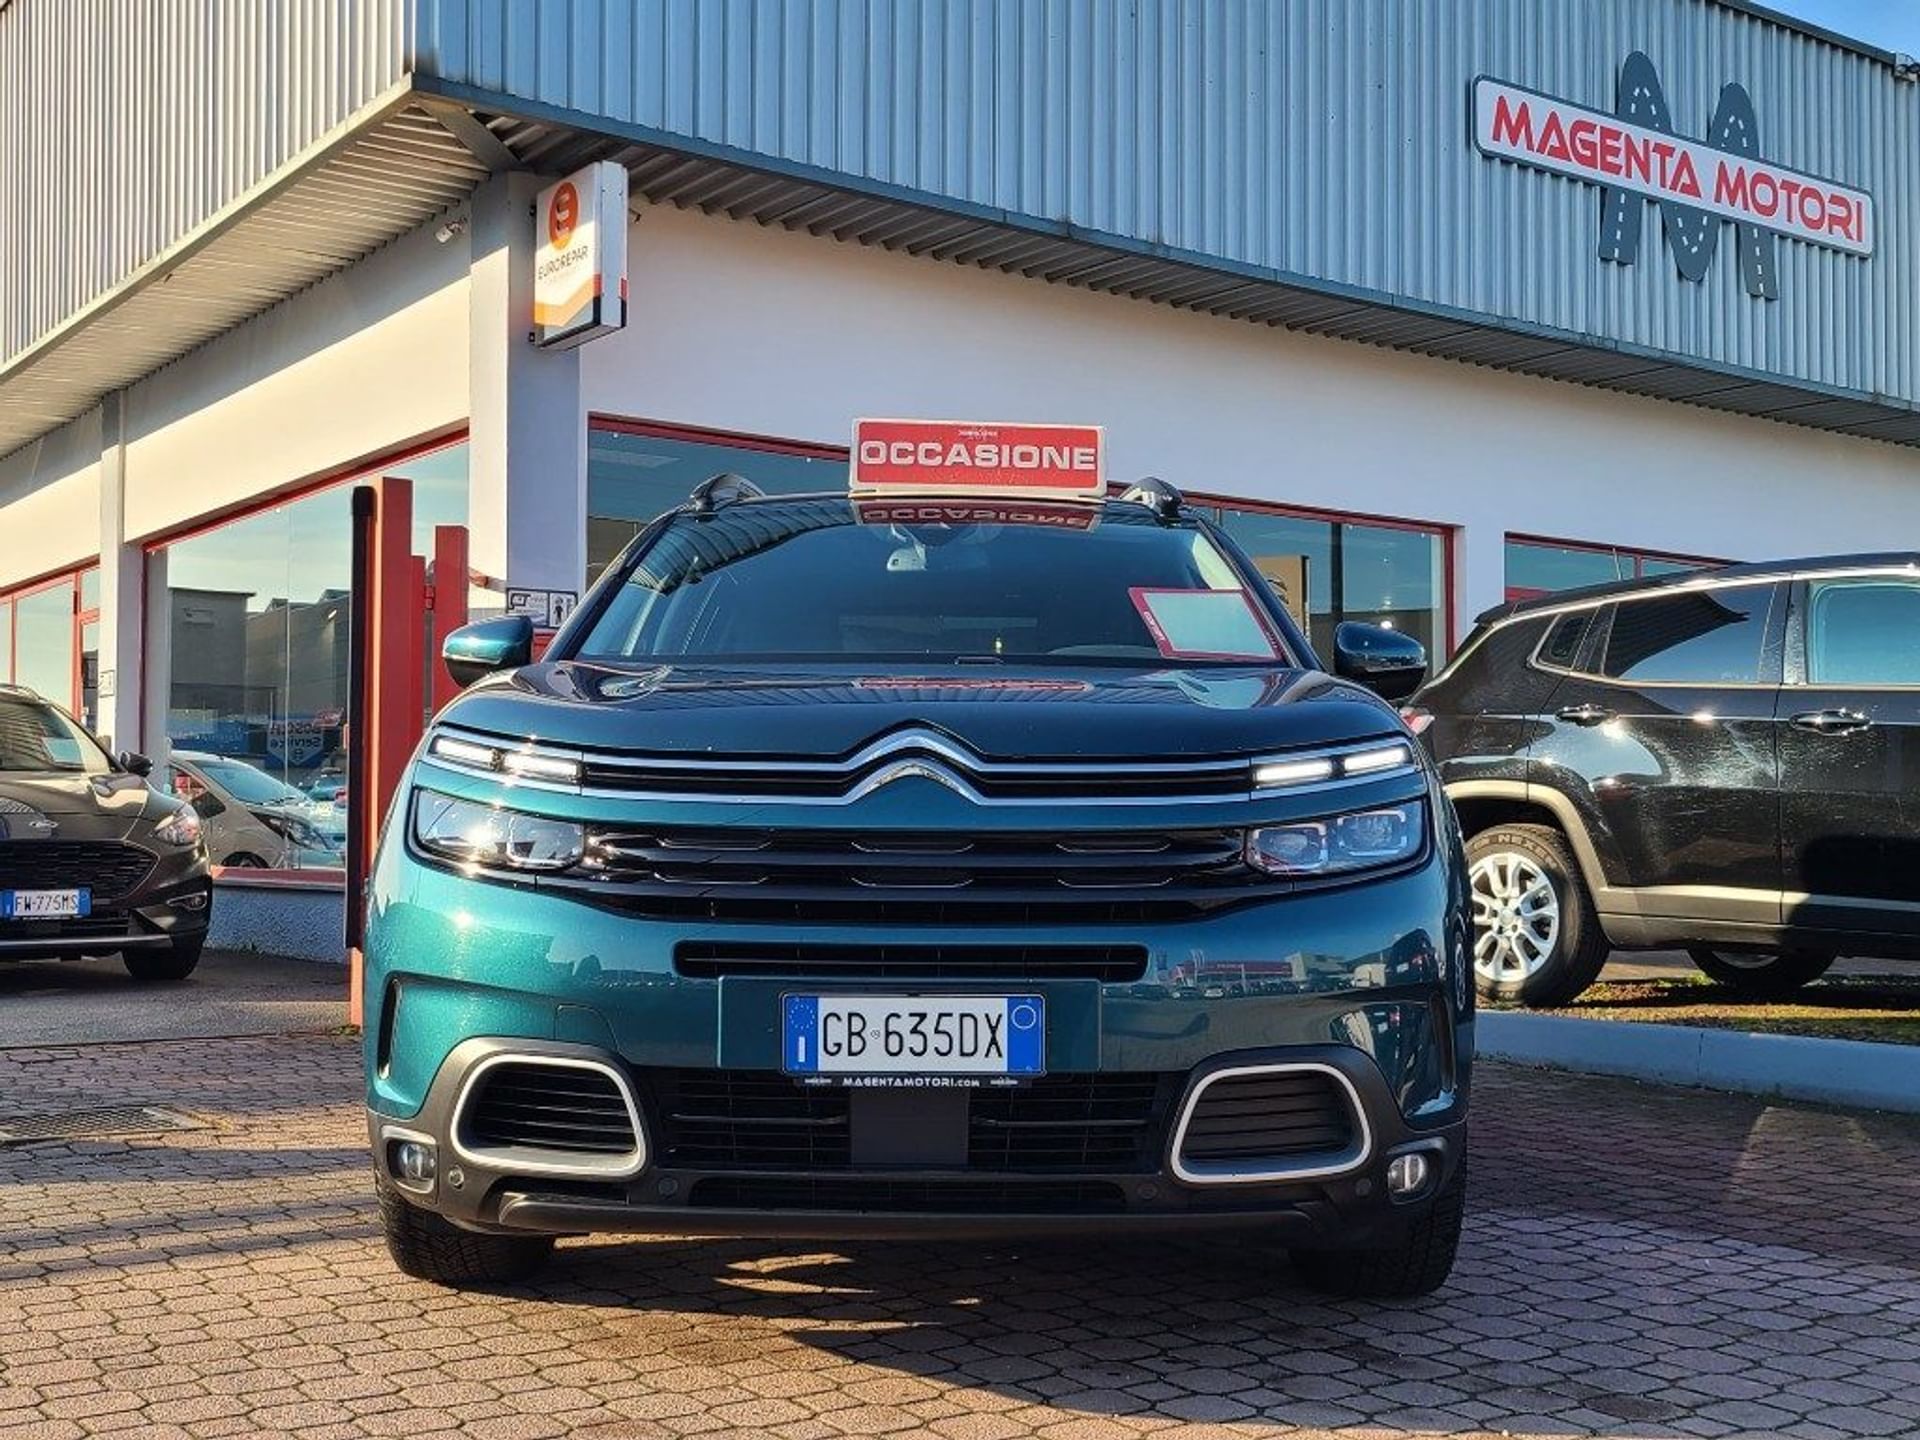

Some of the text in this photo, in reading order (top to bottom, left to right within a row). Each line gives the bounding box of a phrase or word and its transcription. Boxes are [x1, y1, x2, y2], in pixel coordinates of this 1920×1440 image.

[1492, 95, 1863, 243] MAGENTA MOTORI
[538, 245, 588, 280] EUROREPAR
[860, 440, 1097, 470] OCCASIONE
[823, 1012, 1003, 1058] GB 635DX
